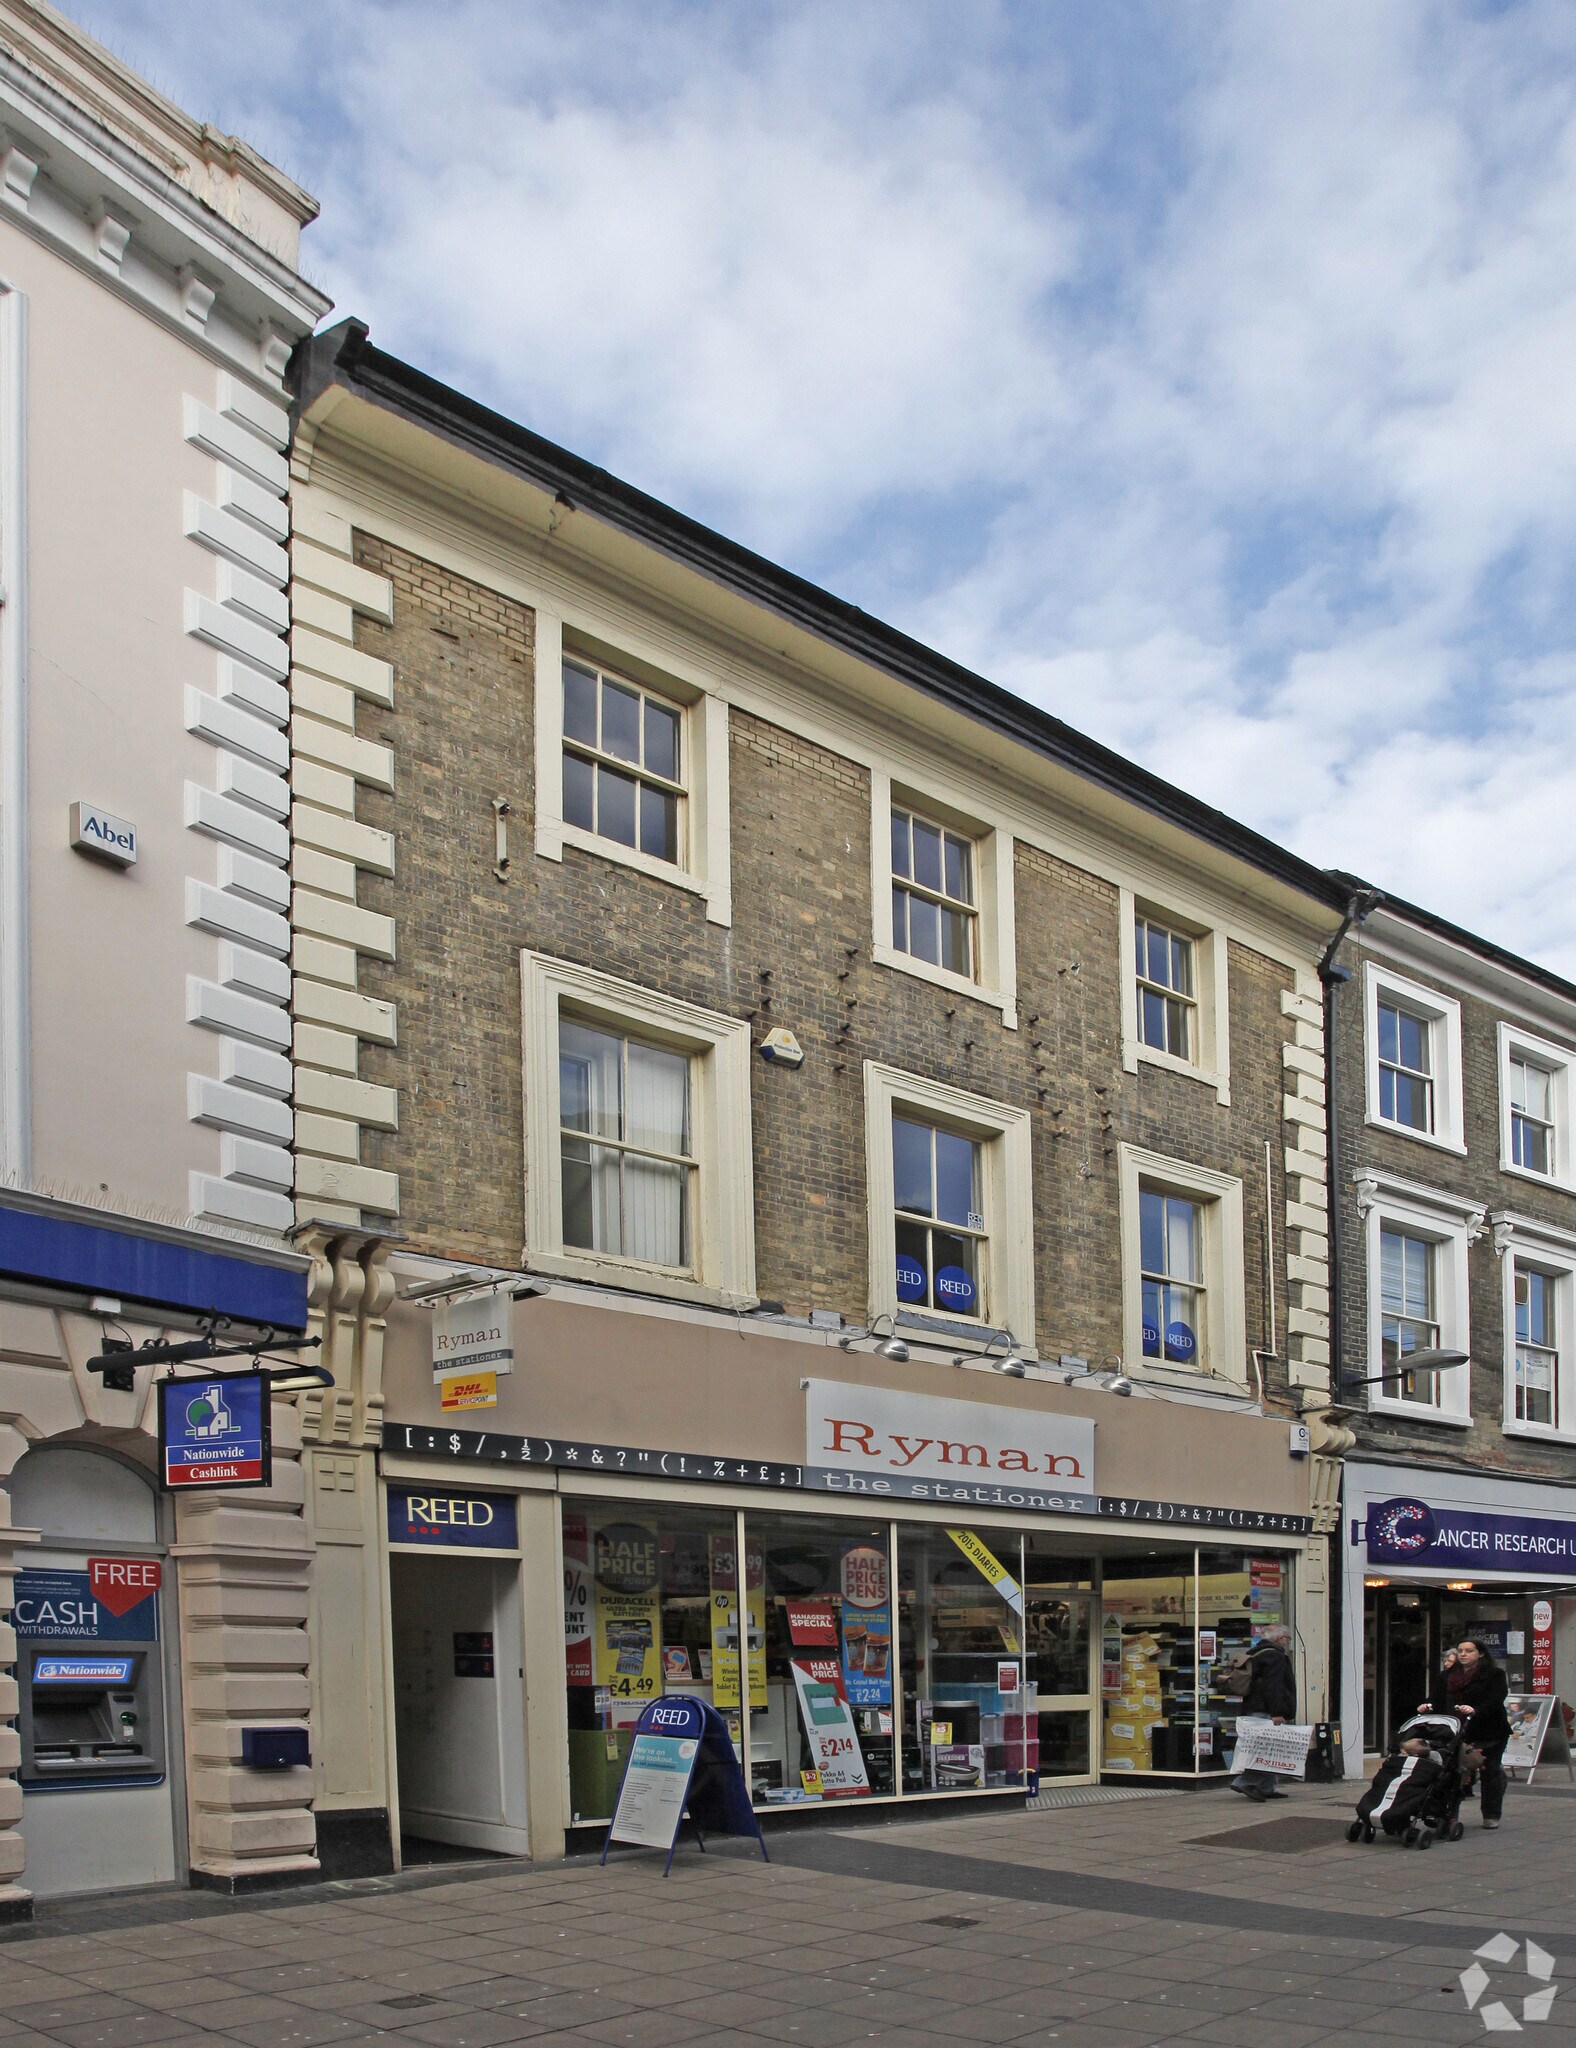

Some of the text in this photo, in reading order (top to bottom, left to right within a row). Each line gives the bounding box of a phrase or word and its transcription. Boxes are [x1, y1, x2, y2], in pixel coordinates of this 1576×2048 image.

[83, 816, 134, 852] Abel
[896, 1269, 922, 1286] EED
[939, 1278, 972, 1297] REED
[436, 1327, 502, 1351] Ryman
[1168, 1333, 1193, 1349] REED
[437, 1351, 502, 1369] the stationer
[452, 1382, 484, 1397] DHL
[183, 1446, 245, 1461] Nationwide
[823, 1417, 1086, 1480] Ryman
[189, 1465, 239, 1479] Cashlink
[822, 1472, 1084, 1511] the stationer
[407, 1496, 494, 1527] REED
[598, 1540, 656, 1559] HALF
[1431, 1529, 1489, 1550] ANCER
[1495, 1533, 1566, 1555] RESEARCH
[957, 1531, 1000, 1578] 2015 DIARIES
[598, 1556, 656, 1576] PRICE
[845, 1556, 887, 1571] HALF
[1252, 1560, 1279, 1568] Ryman
[94, 1562, 157, 1587] FREE
[845, 1570, 887, 1585] PRICE
[845, 1583, 887, 1600] PENS
[600, 1596, 656, 1606] DURACELL
[15, 1599, 99, 1625] CASH
[790, 1613, 831, 1621] MANAGER'S
[17, 1625, 99, 1636] WITHDRAWALS
[791, 1619, 833, 1628] SPECIAL
[1532, 1637, 1550, 1648] sale
[810, 1662, 837, 1671] HALF
[1532, 1655, 1551, 1666] 75%
[59, 1665, 122, 1675] Nationwide
[570, 1669, 590, 1677] CARD
[812, 1669, 840, 1679] PRICE
[609, 1677, 654, 1697] £4.49
[1532, 1675, 1550, 1686] sale
[856, 1688, 881, 1702] £2.24
[651, 1708, 690, 1726] REED
[820, 1737, 854, 1757] £2.14
[1255, 1757, 1297, 1769] Ryman
